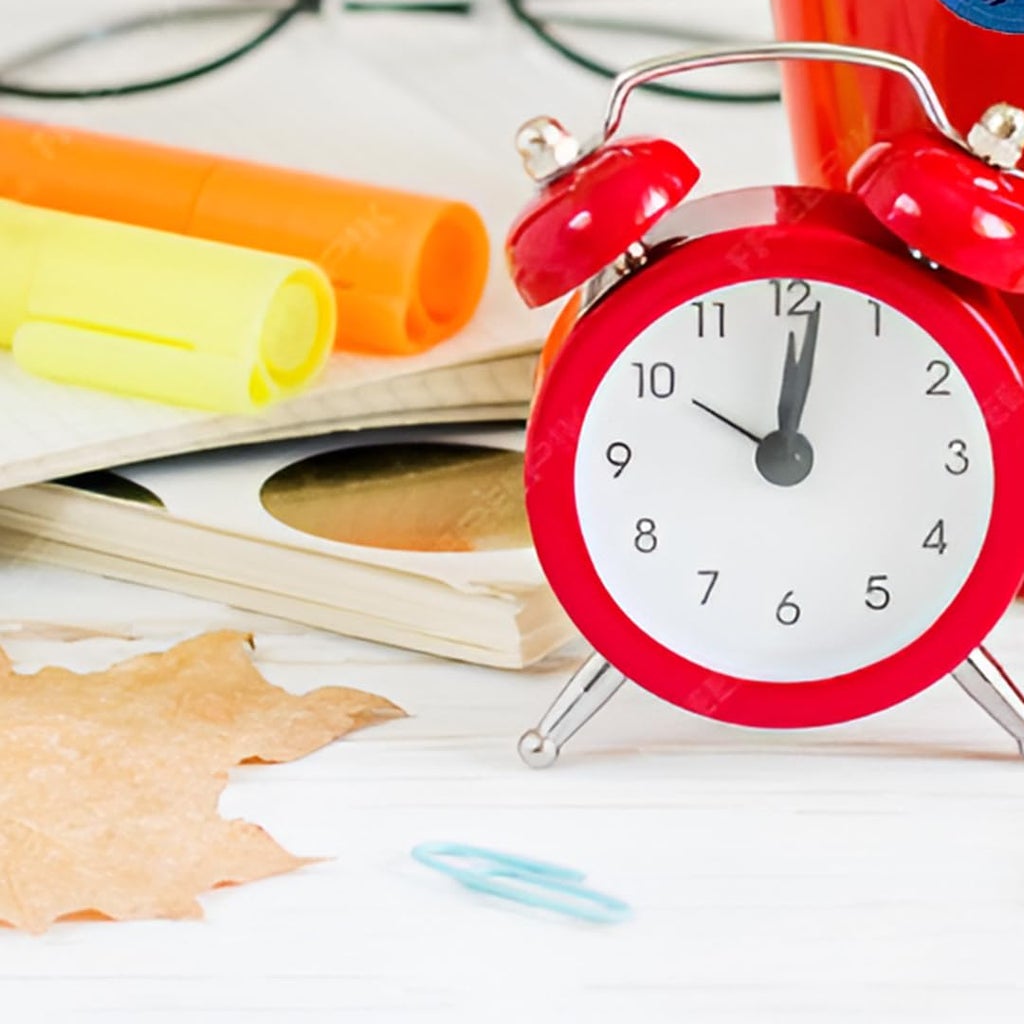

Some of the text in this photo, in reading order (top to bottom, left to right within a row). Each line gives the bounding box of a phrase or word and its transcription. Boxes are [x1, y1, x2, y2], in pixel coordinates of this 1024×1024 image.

[769, 279, 812, 317] 12
[690, 300, 725, 339] 11
[867, 299, 881, 337] 1
[631, 362, 676, 399] 10
[925, 359, 951, 396] 2
[605, 441, 632, 479] 9
[945, 439, 970, 476] 3
[633, 518, 659, 554] 8
[921, 519, 948, 555] 4
[697, 570, 719, 605] 7
[864, 575, 891, 611] 5
[775, 590, 801, 627] 6
